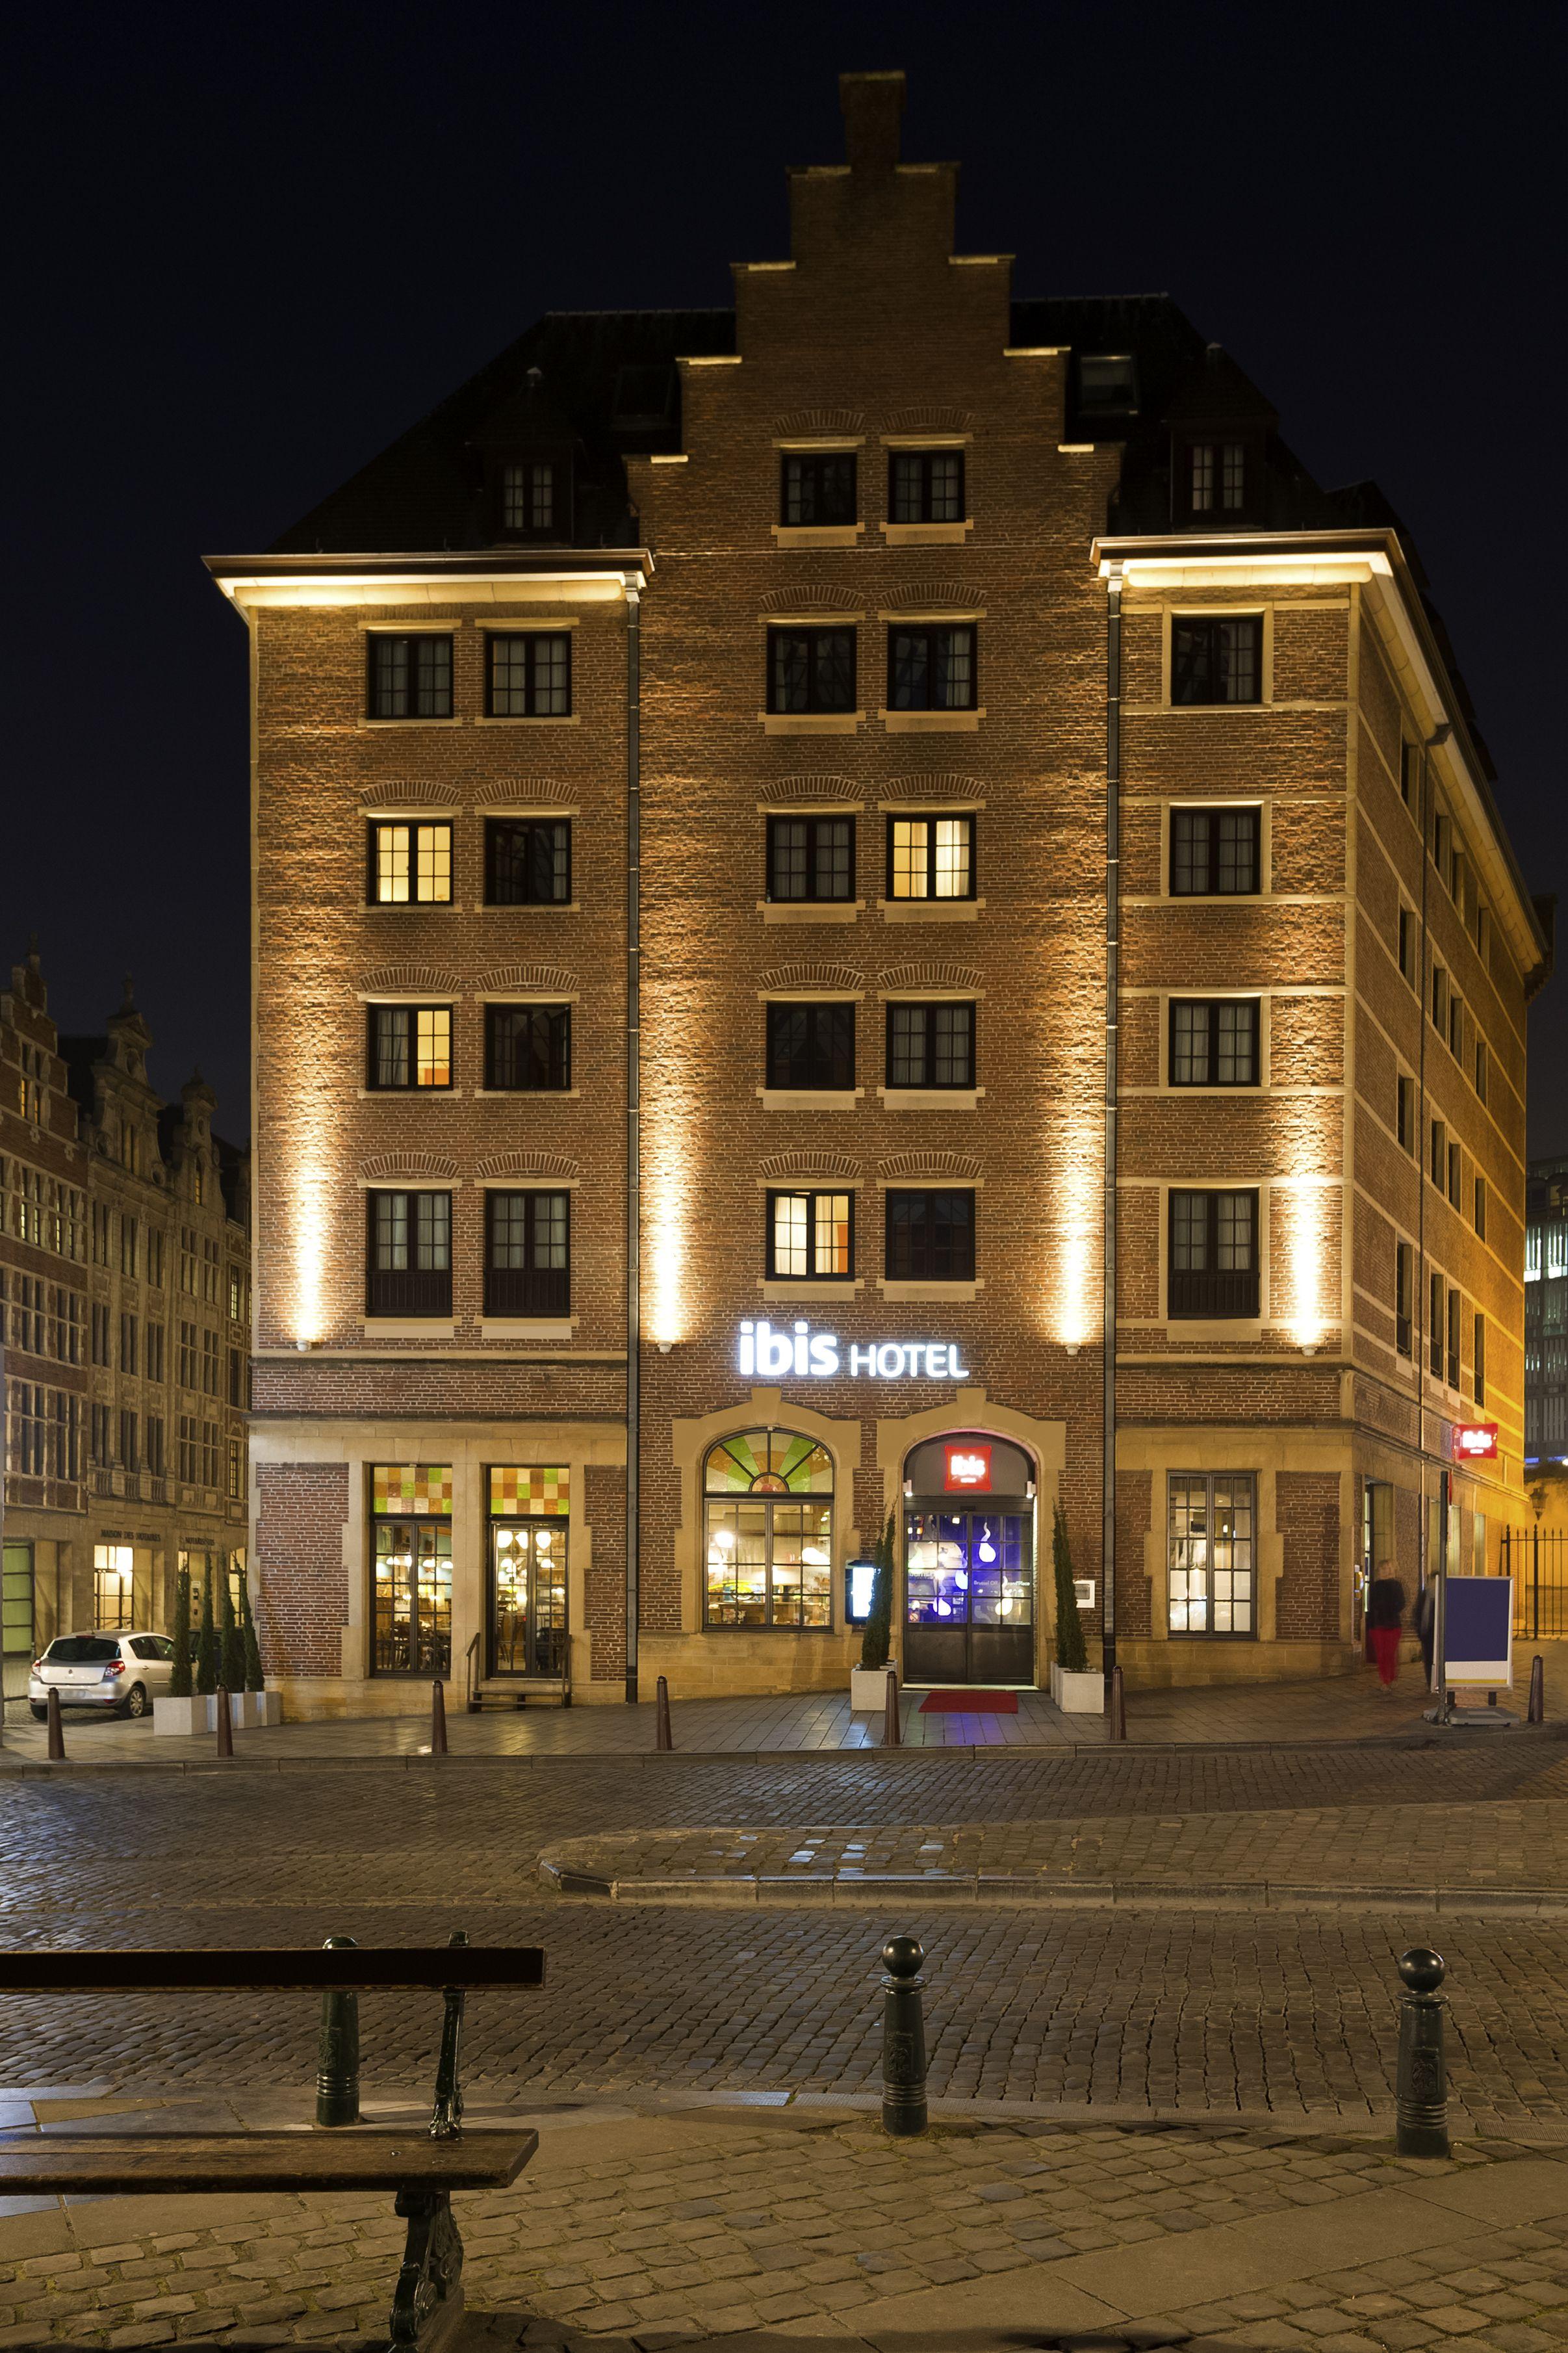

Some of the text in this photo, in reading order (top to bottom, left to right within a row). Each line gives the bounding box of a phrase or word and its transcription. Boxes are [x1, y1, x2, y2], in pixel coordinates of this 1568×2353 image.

[740, 1321, 970, 1377] ibis HOTEL
[951, 1455, 986, 1476] ibis
[101, 1529, 161, 1542] MAISON DES NOTAIRES
